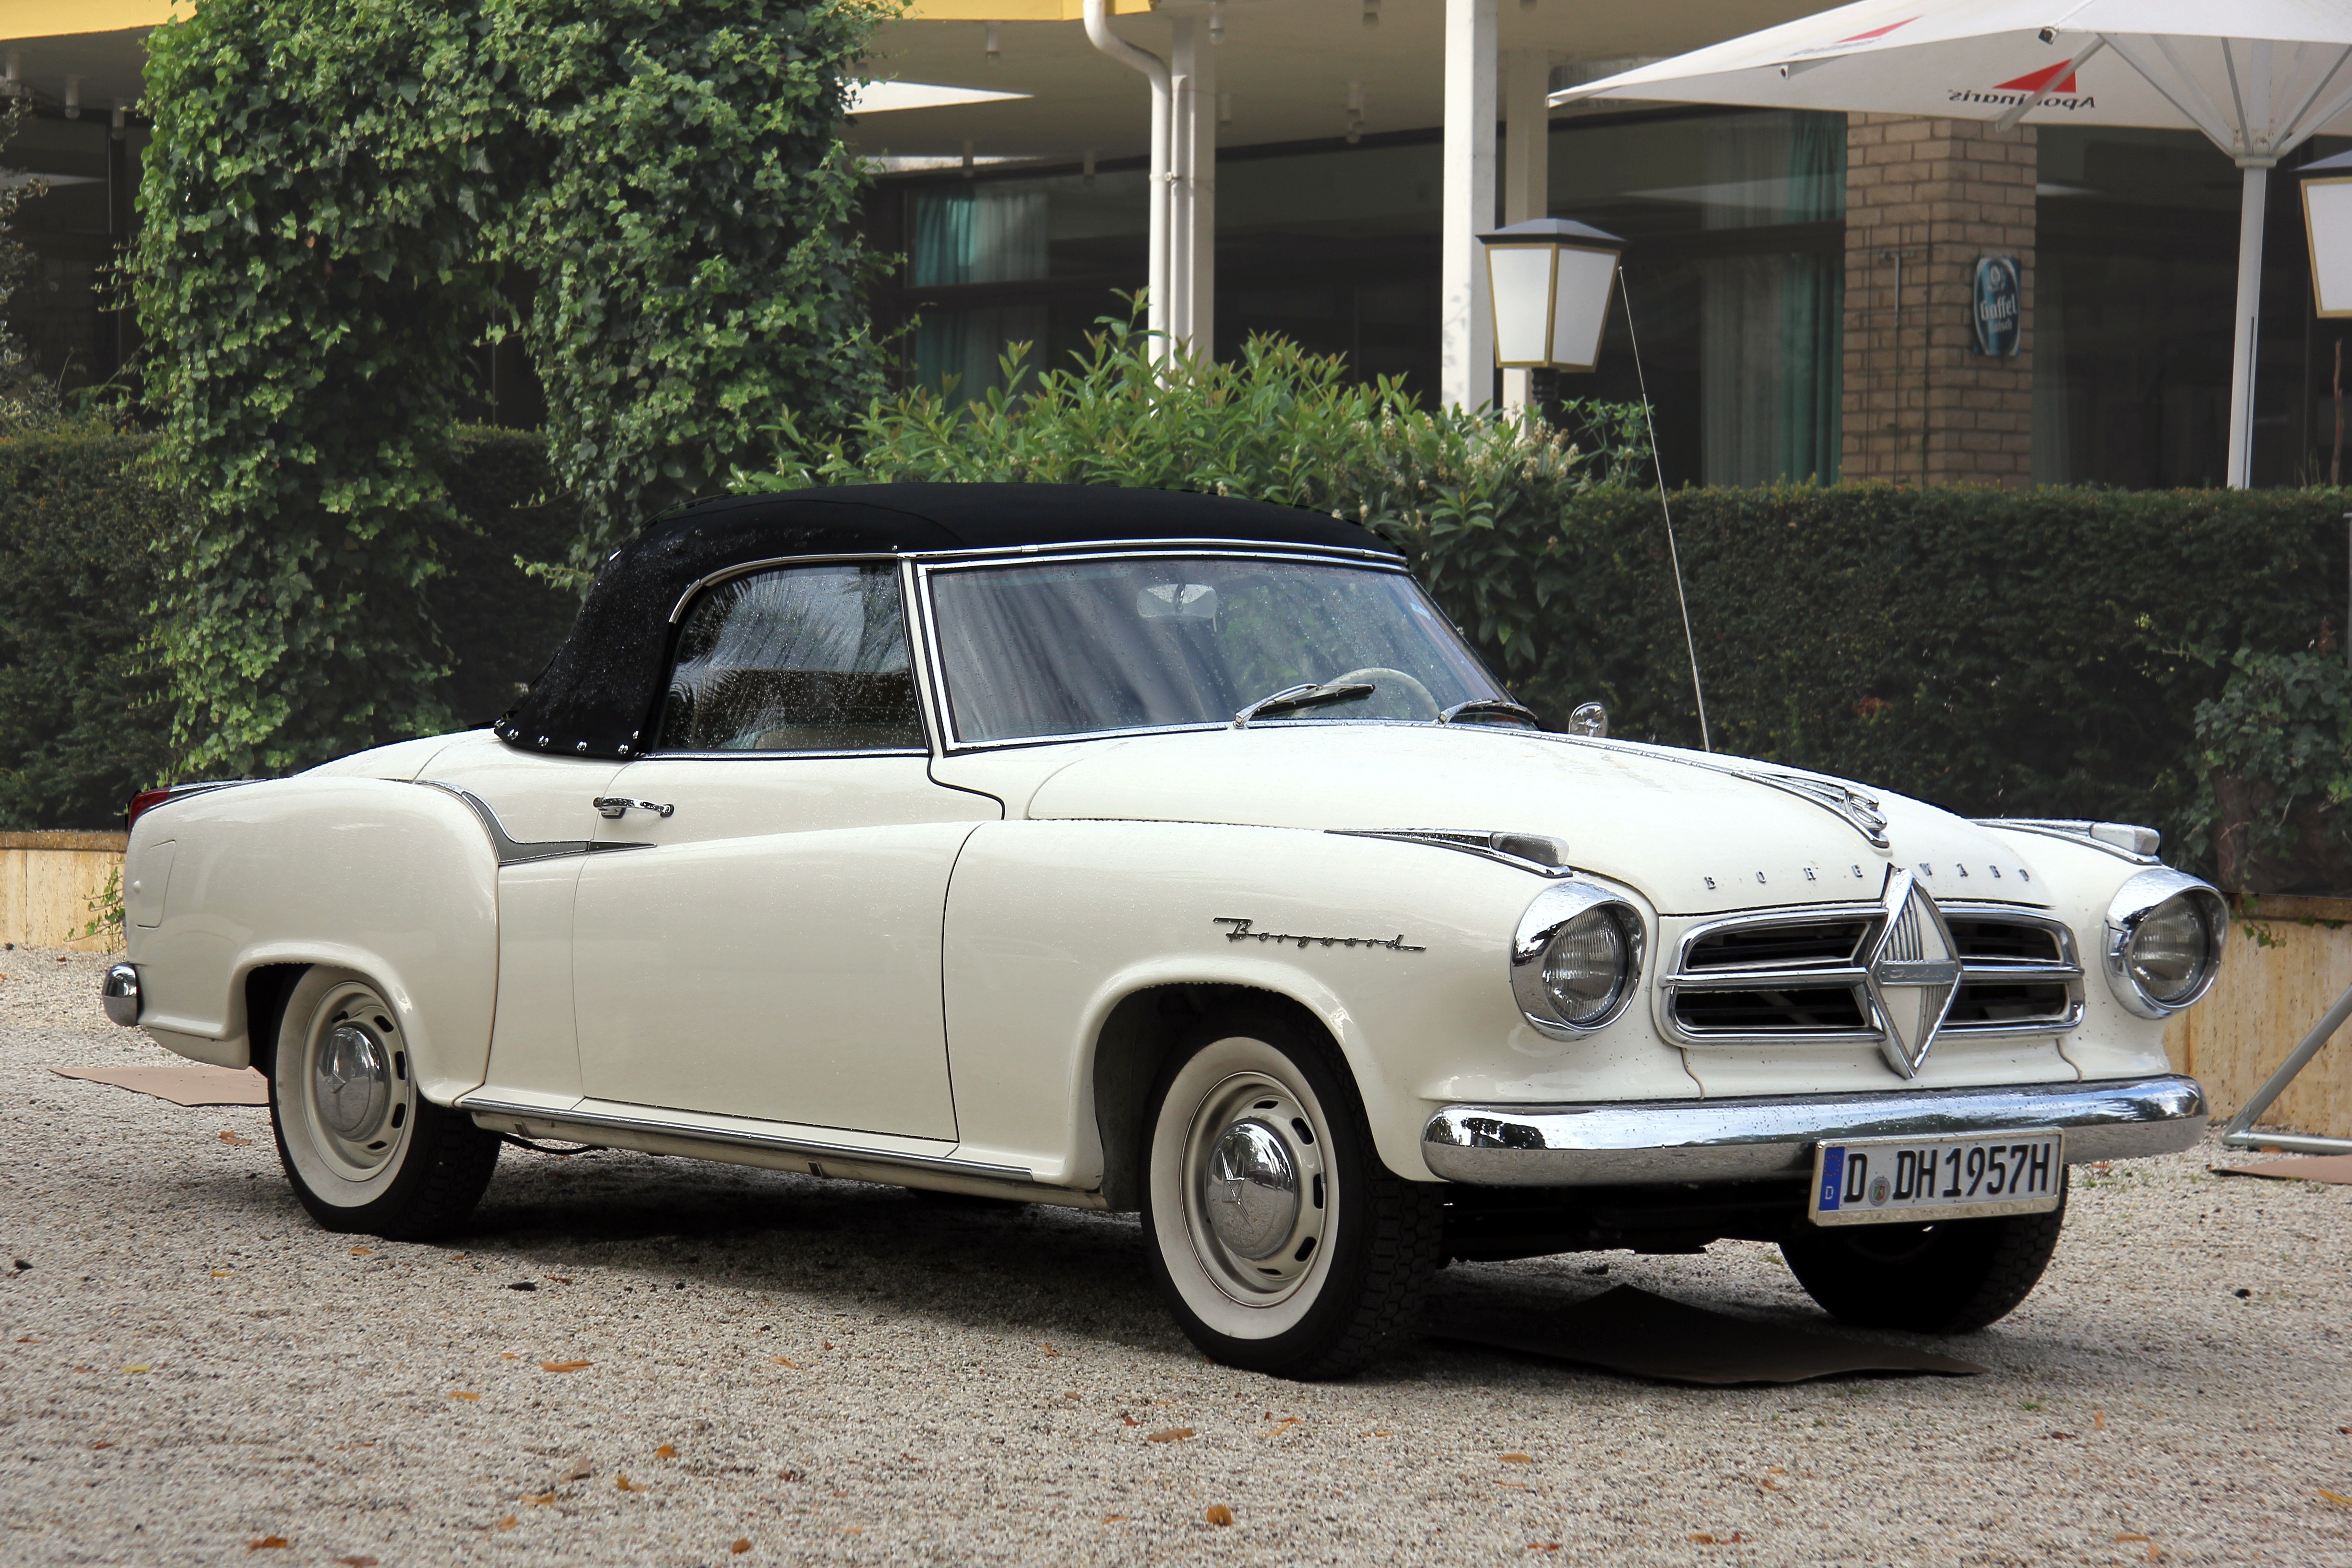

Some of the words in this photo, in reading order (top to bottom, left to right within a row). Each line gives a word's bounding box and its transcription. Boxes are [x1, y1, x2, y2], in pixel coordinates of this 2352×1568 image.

[1980, 294, 2017, 321] Gaffel
[1212, 917, 1426, 951] Borgward
[1843, 1152, 1868, 1202] D
[1825, 1186, 1833, 1200] D
